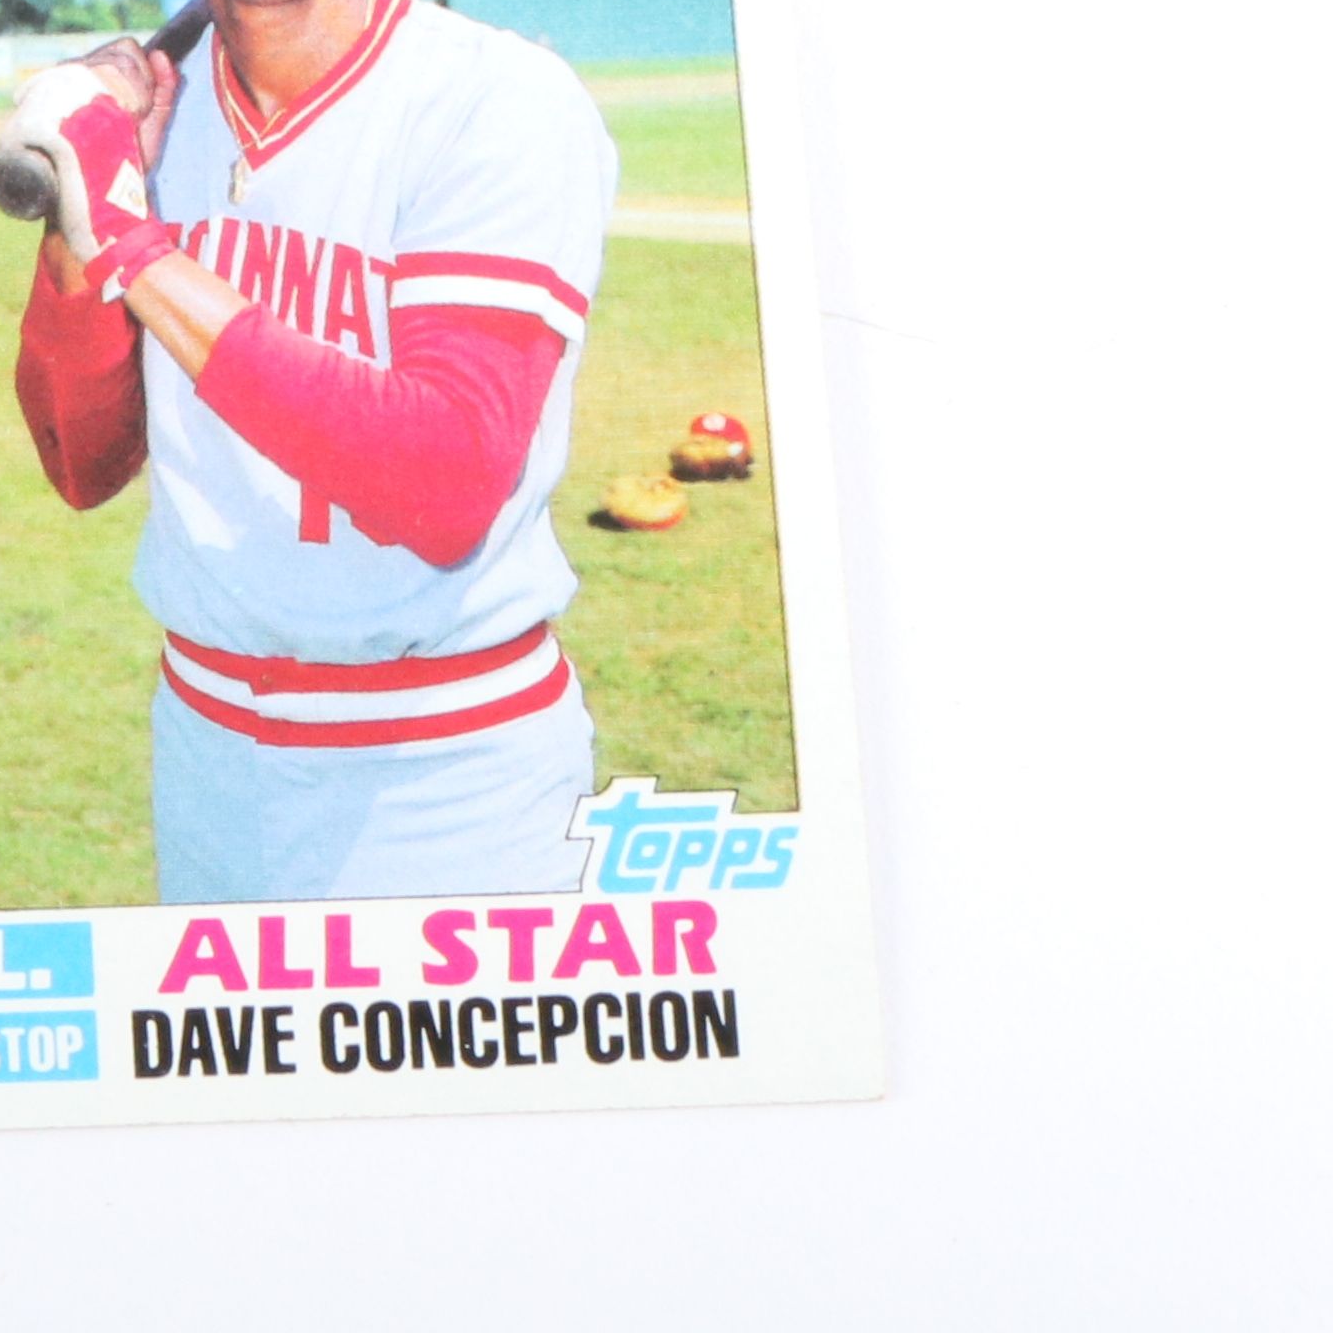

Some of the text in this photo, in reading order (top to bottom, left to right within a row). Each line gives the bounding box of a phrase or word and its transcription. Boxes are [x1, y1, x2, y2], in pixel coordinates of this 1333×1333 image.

[587, 788, 800, 891] topps
[158, 901, 718, 995] ALL STAR
[133, 990, 741, 1081] DAVE CONCEPCION
